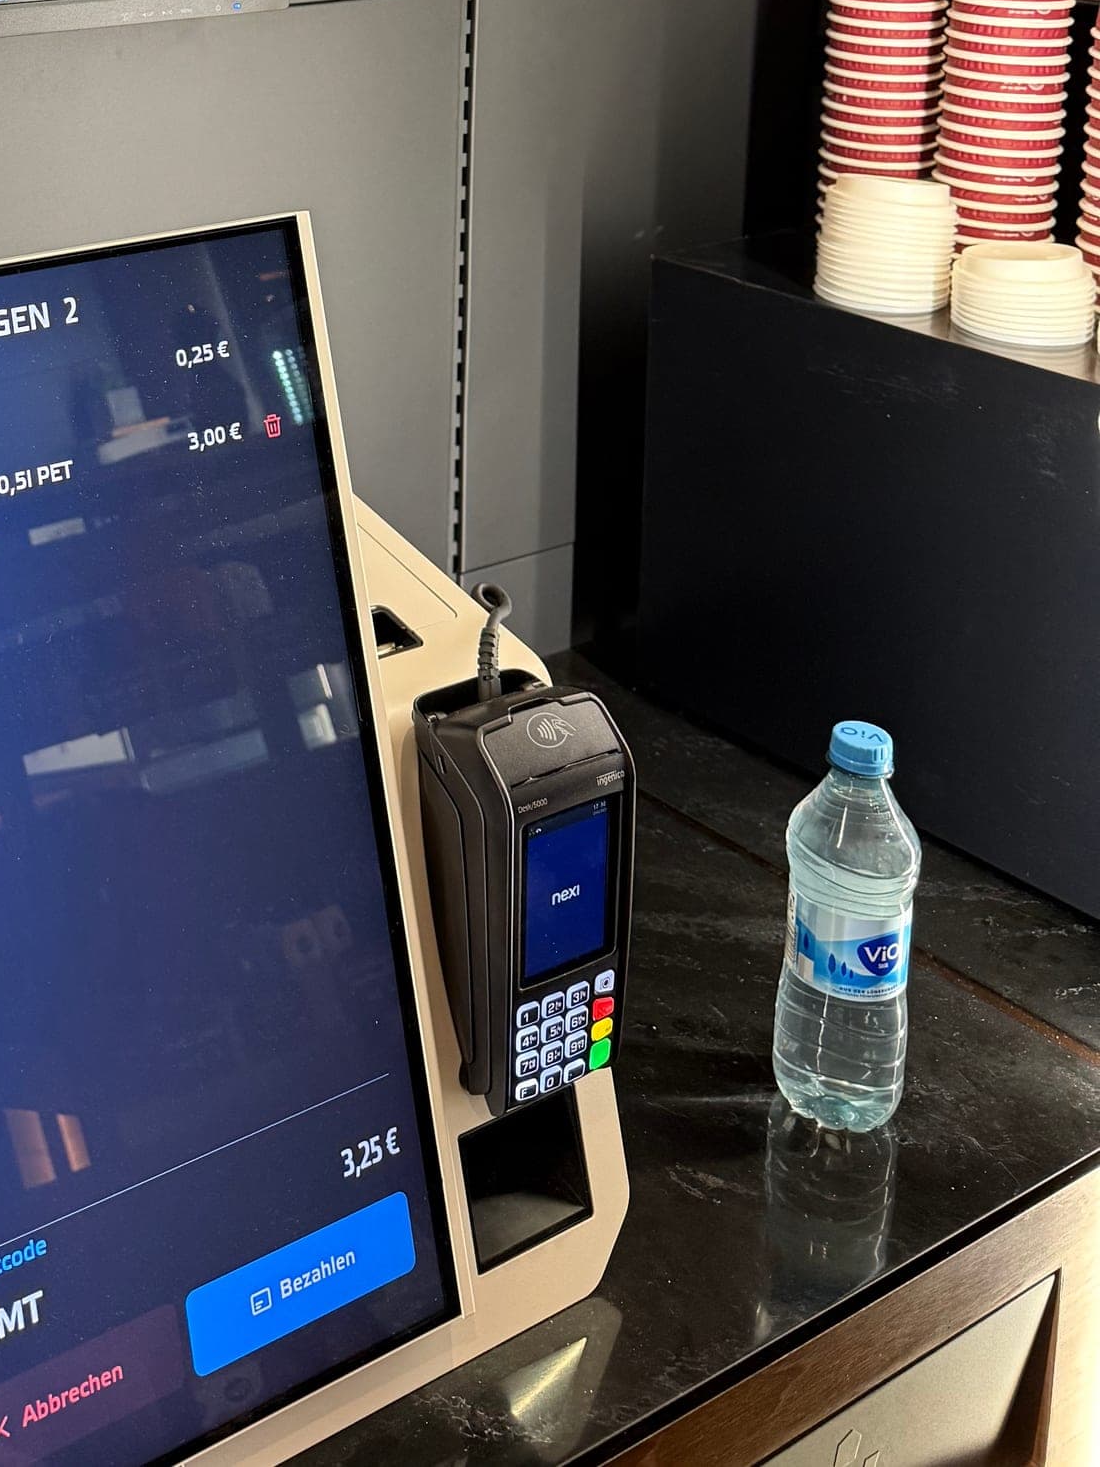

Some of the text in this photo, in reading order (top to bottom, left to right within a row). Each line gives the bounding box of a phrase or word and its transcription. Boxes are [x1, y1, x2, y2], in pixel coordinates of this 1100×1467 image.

[63, 296, 79, 325] 2
[175, 340, 230, 369] 0,25 €
[187, 421, 243, 452] 3,00 €
[36, 459, 75, 486] PET
[595, 769, 626, 787] ingenico
[551, 883, 580, 906] nexi
[340, 1126, 401, 1178] 3,25 €
[279, 1249, 357, 1300] Bezahlen
[21, 1364, 124, 1428] Abbrechen
